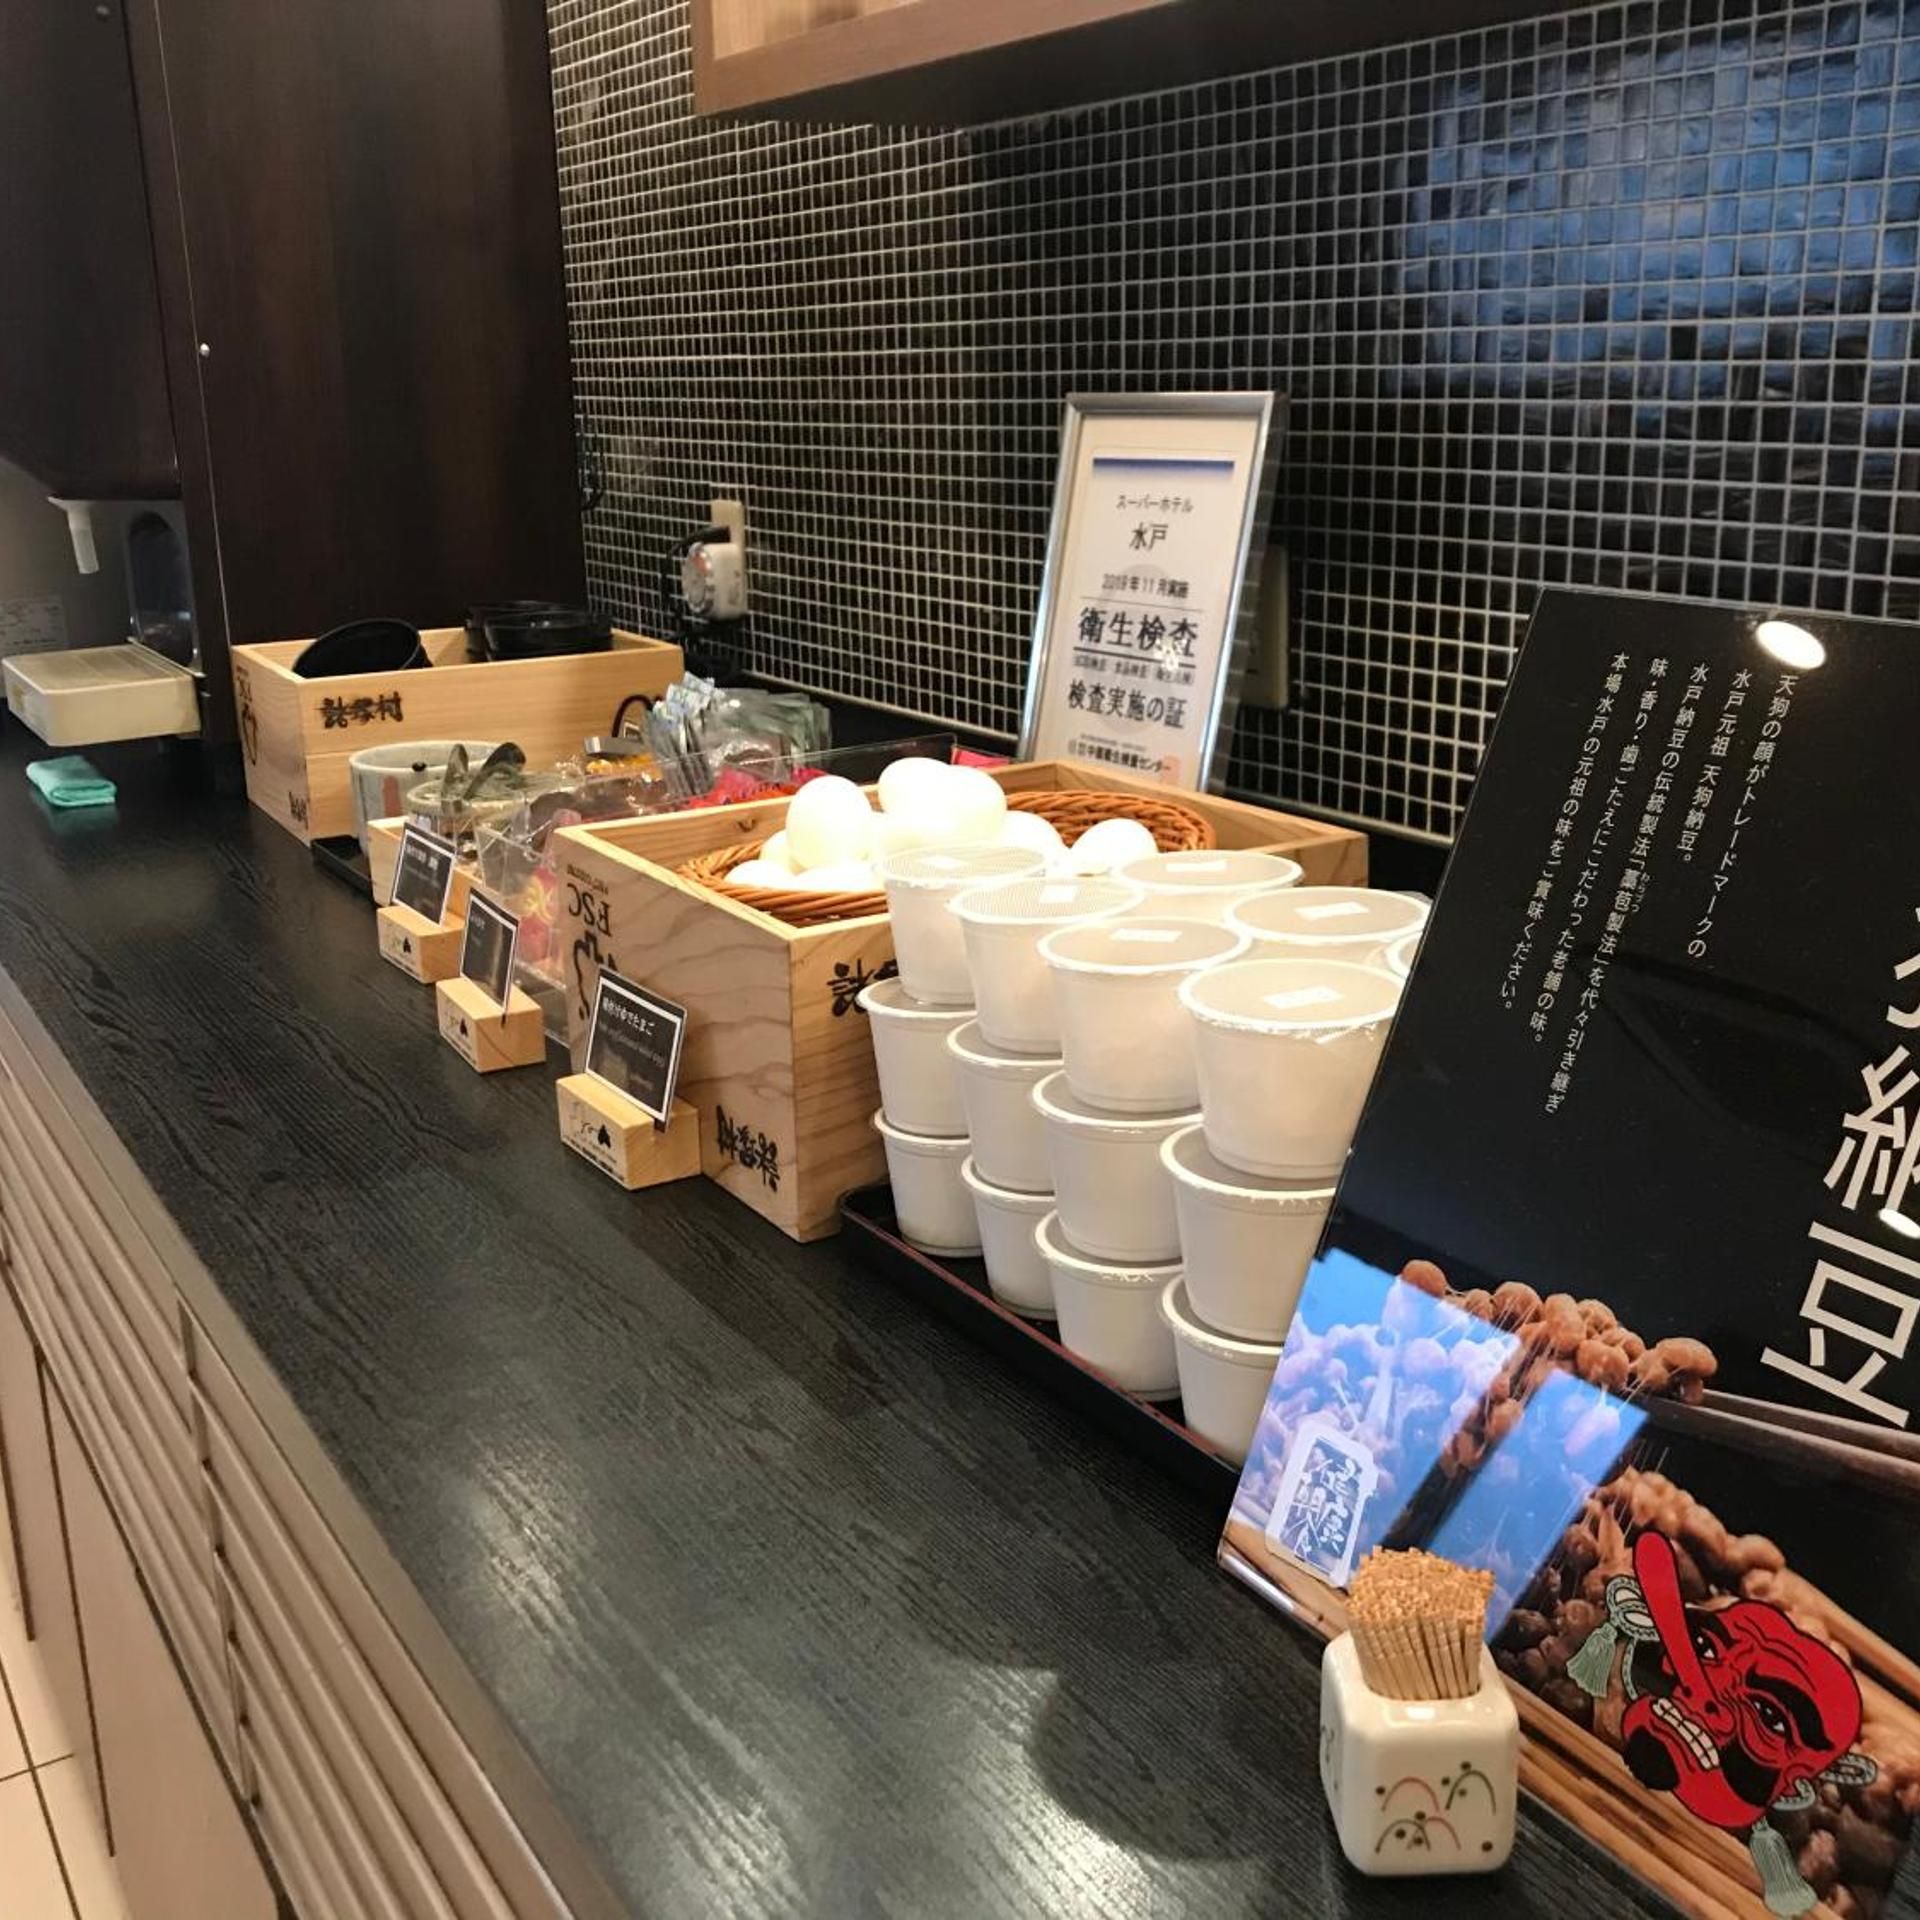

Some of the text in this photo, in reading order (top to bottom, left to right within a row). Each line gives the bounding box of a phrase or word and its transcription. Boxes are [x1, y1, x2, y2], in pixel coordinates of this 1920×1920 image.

[1116, 494, 1194, 513] スーパーホテル
[1129, 522, 1169, 550] 水戸
[1078, 605, 1199, 657] 衛生検査
[1067, 679, 1188, 729] 検査実施の証
[1676, 668, 1753, 862] 水戸元祖 天狗納豆。
[1501, 652, 1630, 1009] 本場水戸の元祖の味をご賞味ください。
[1687, 674, 1799, 958] 天狗の顔がトレードマークの
